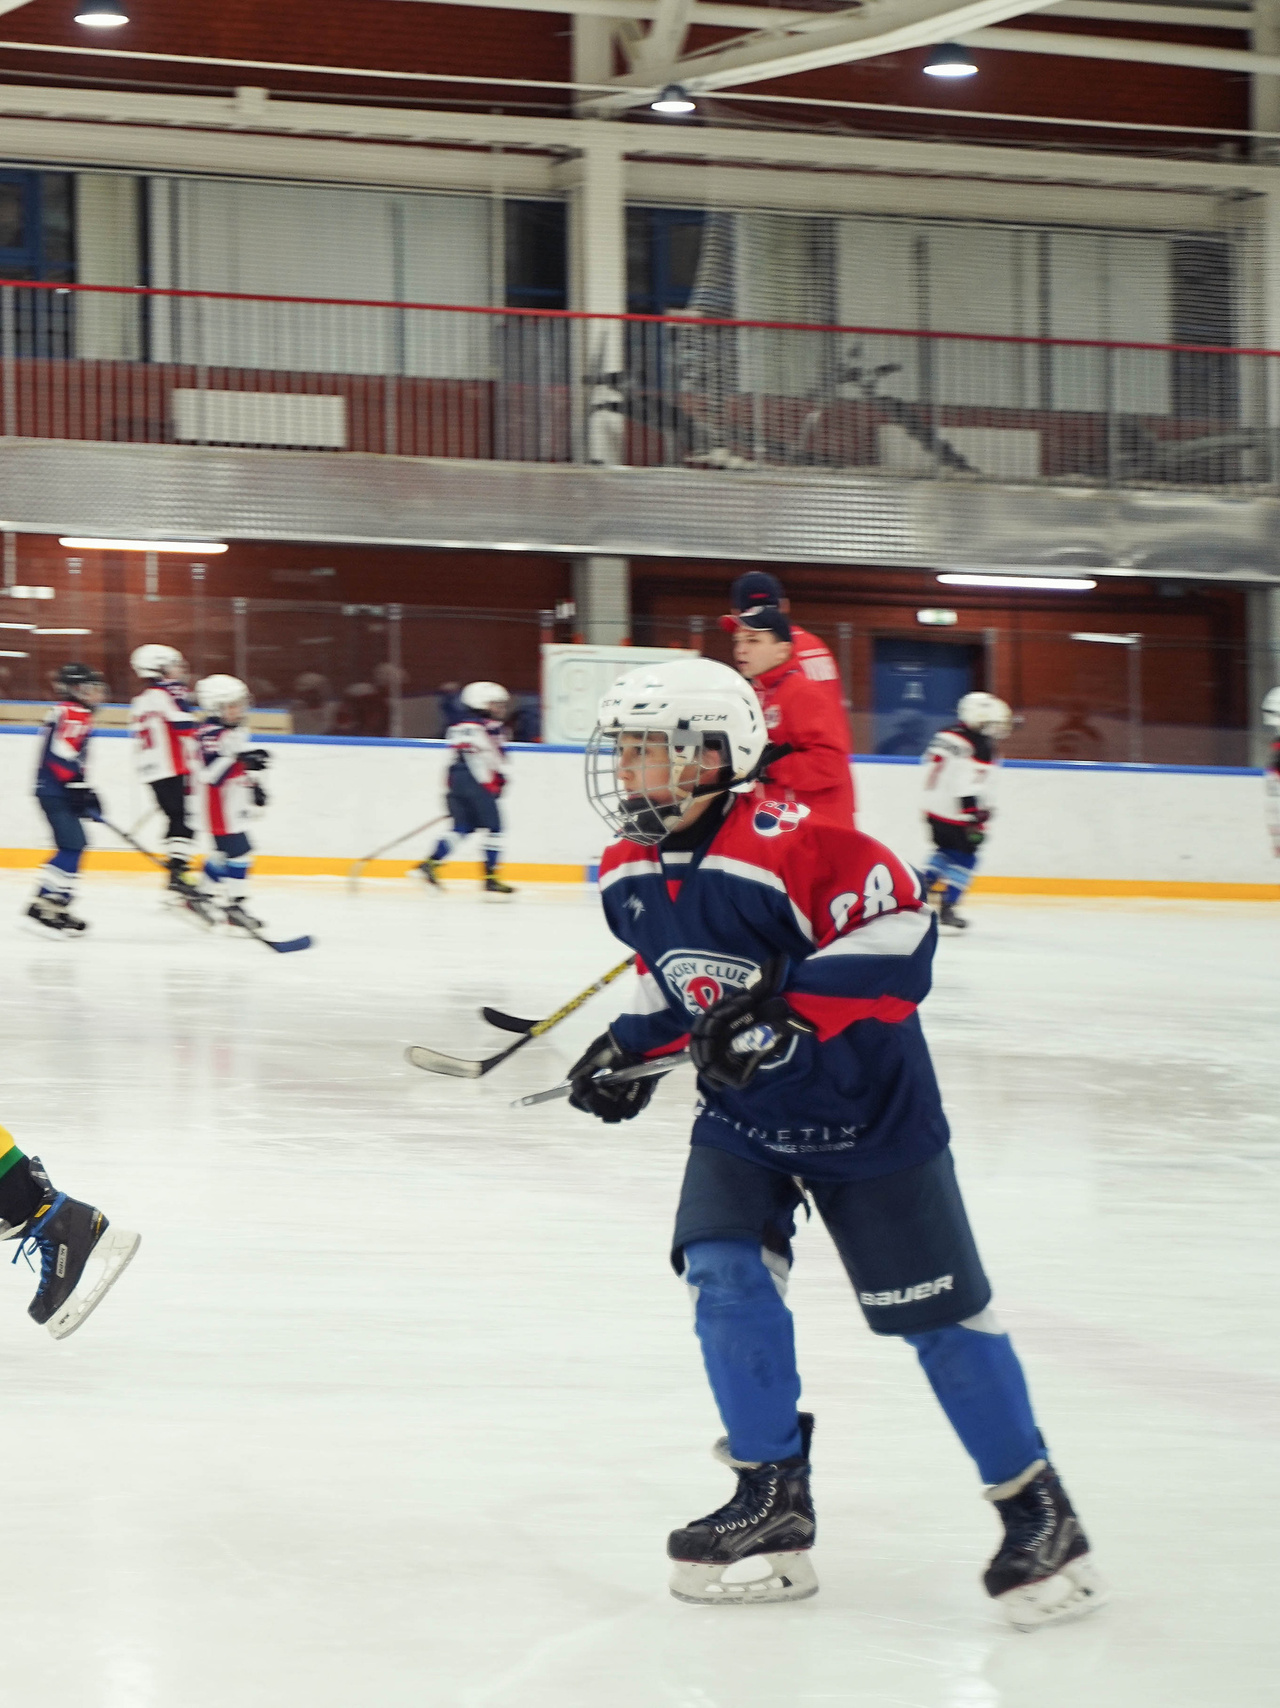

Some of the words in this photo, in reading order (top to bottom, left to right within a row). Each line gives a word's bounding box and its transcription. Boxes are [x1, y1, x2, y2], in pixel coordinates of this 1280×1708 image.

[690, 714, 728, 722] CCM
[666, 962, 697, 981] OCKEY
[860, 1275, 954, 1306] BAUER
